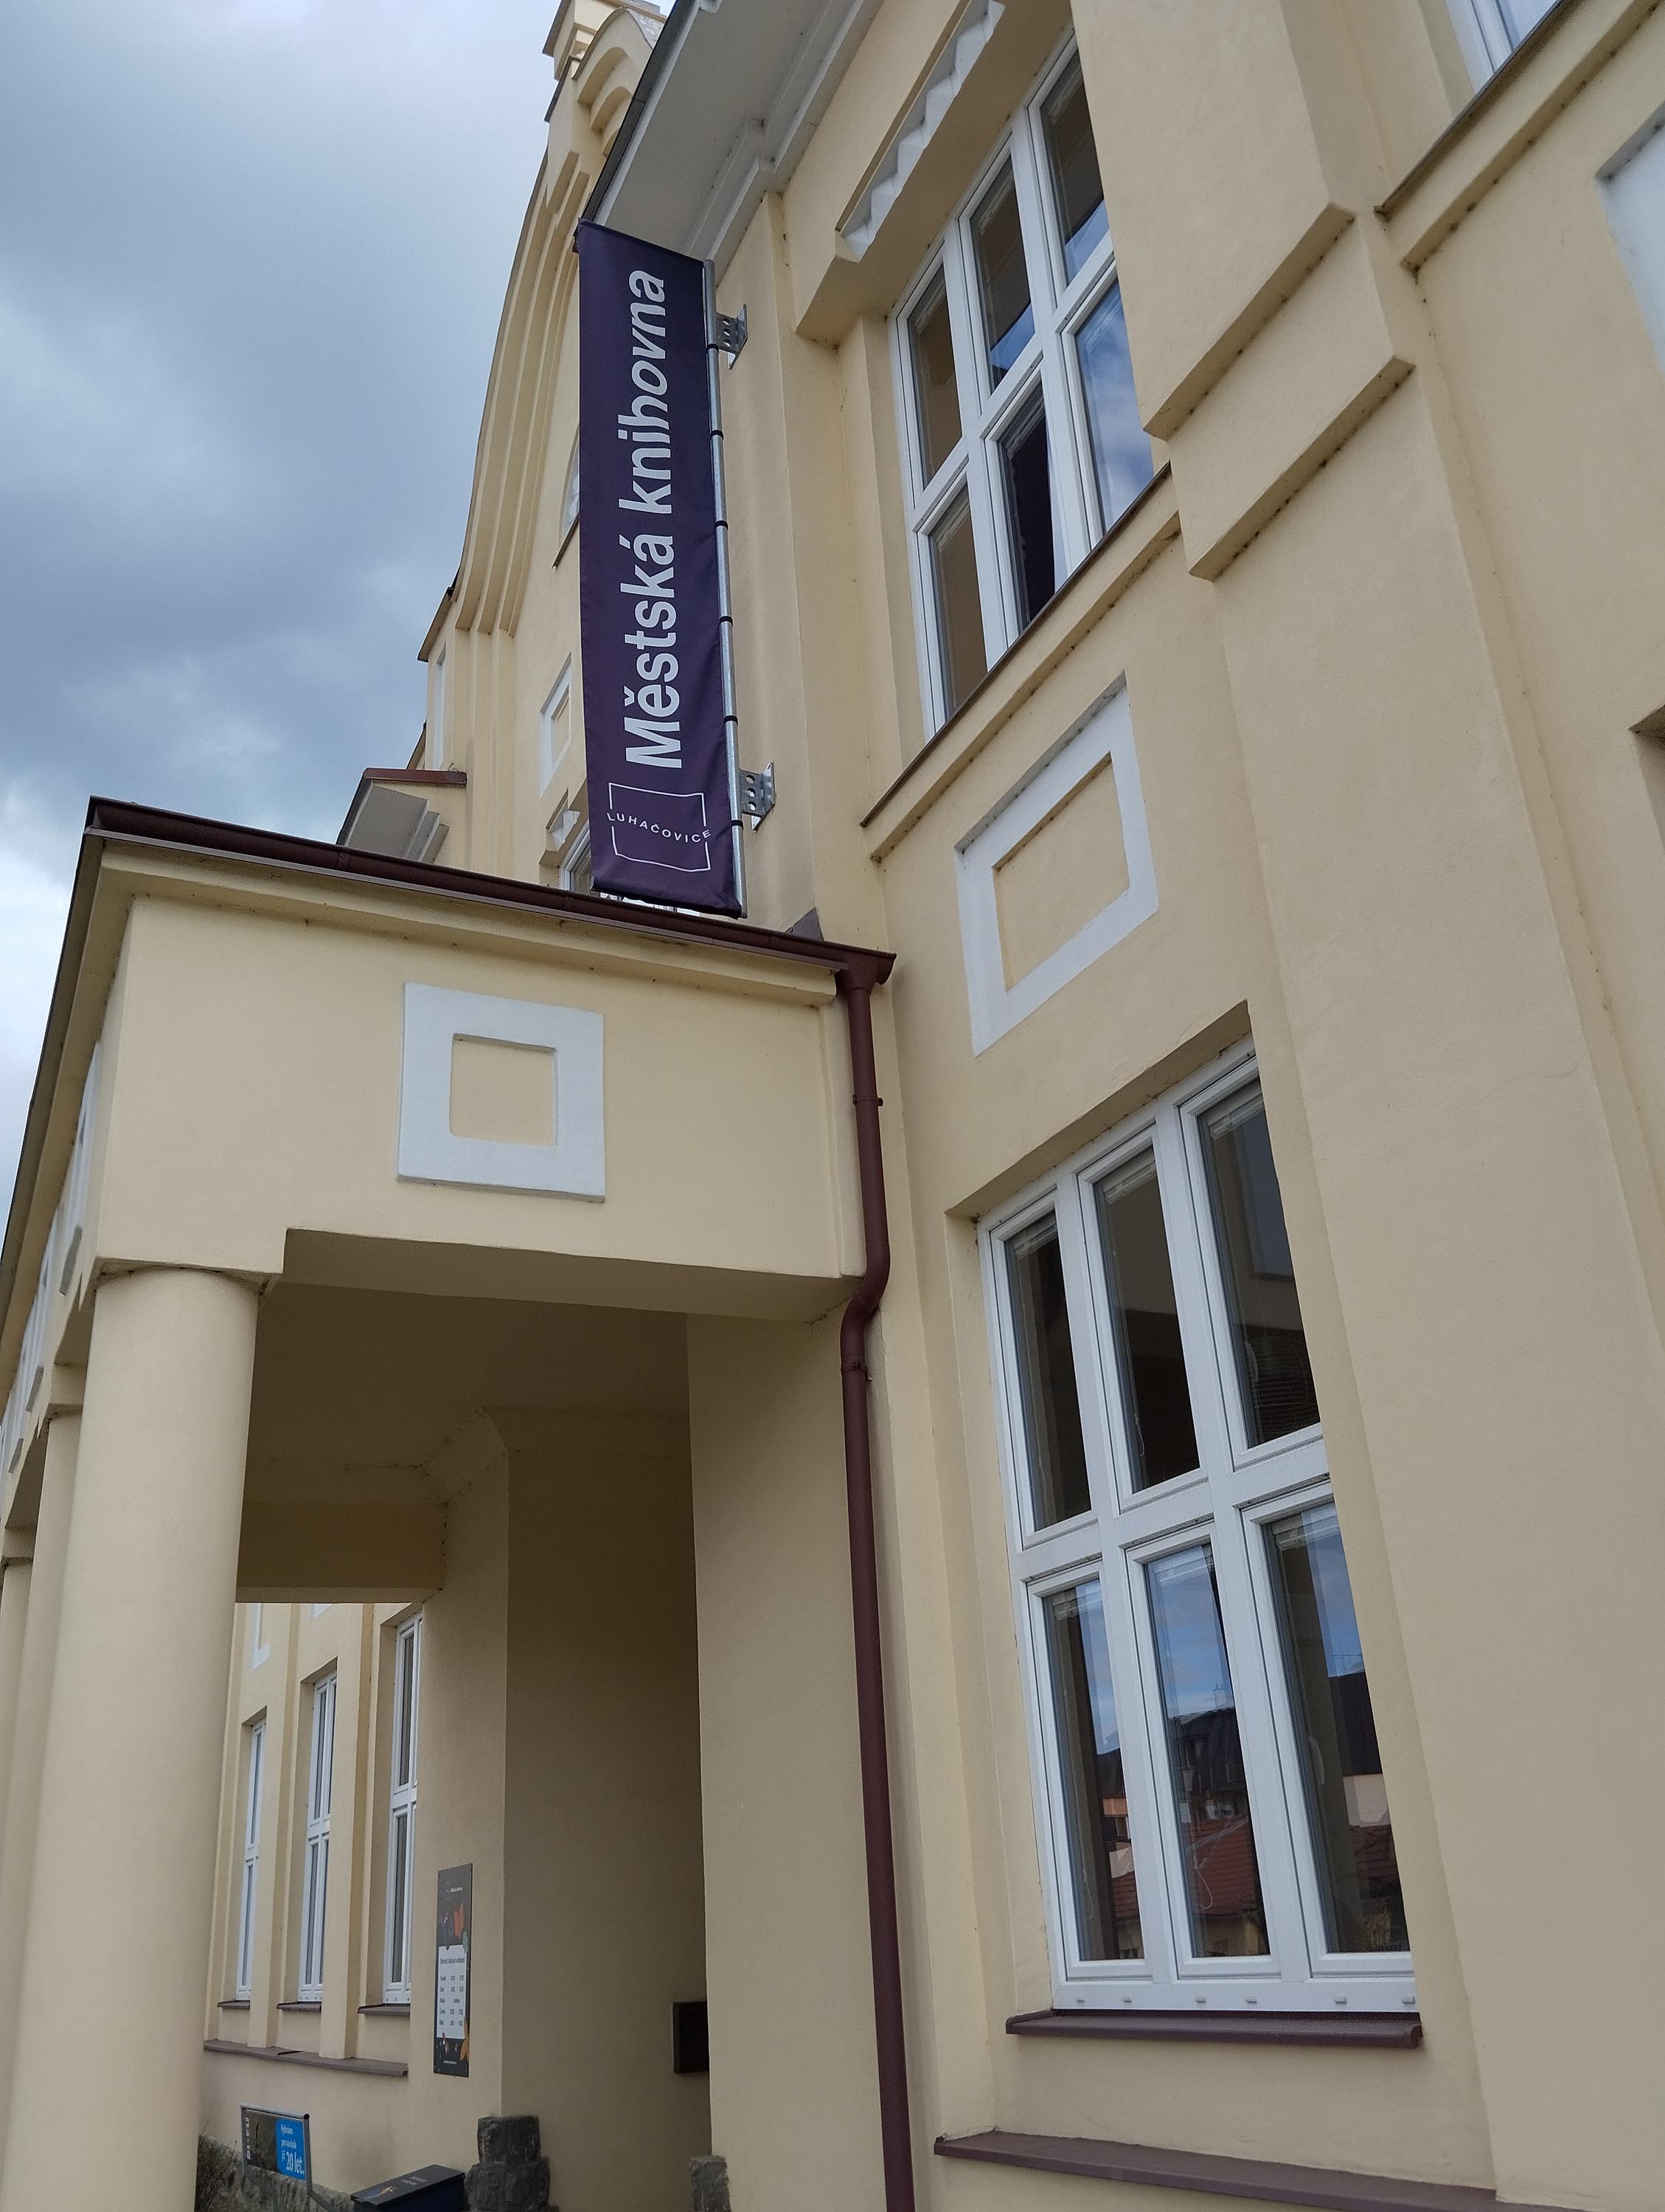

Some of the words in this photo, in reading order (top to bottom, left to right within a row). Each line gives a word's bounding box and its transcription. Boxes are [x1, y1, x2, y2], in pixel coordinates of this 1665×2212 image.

[618, 269, 672, 514] knihovna
[619, 534, 682, 769] Městská
[607, 812, 712, 843] LUHAČOVICE
[285, 2152, 293, 2171] 20
